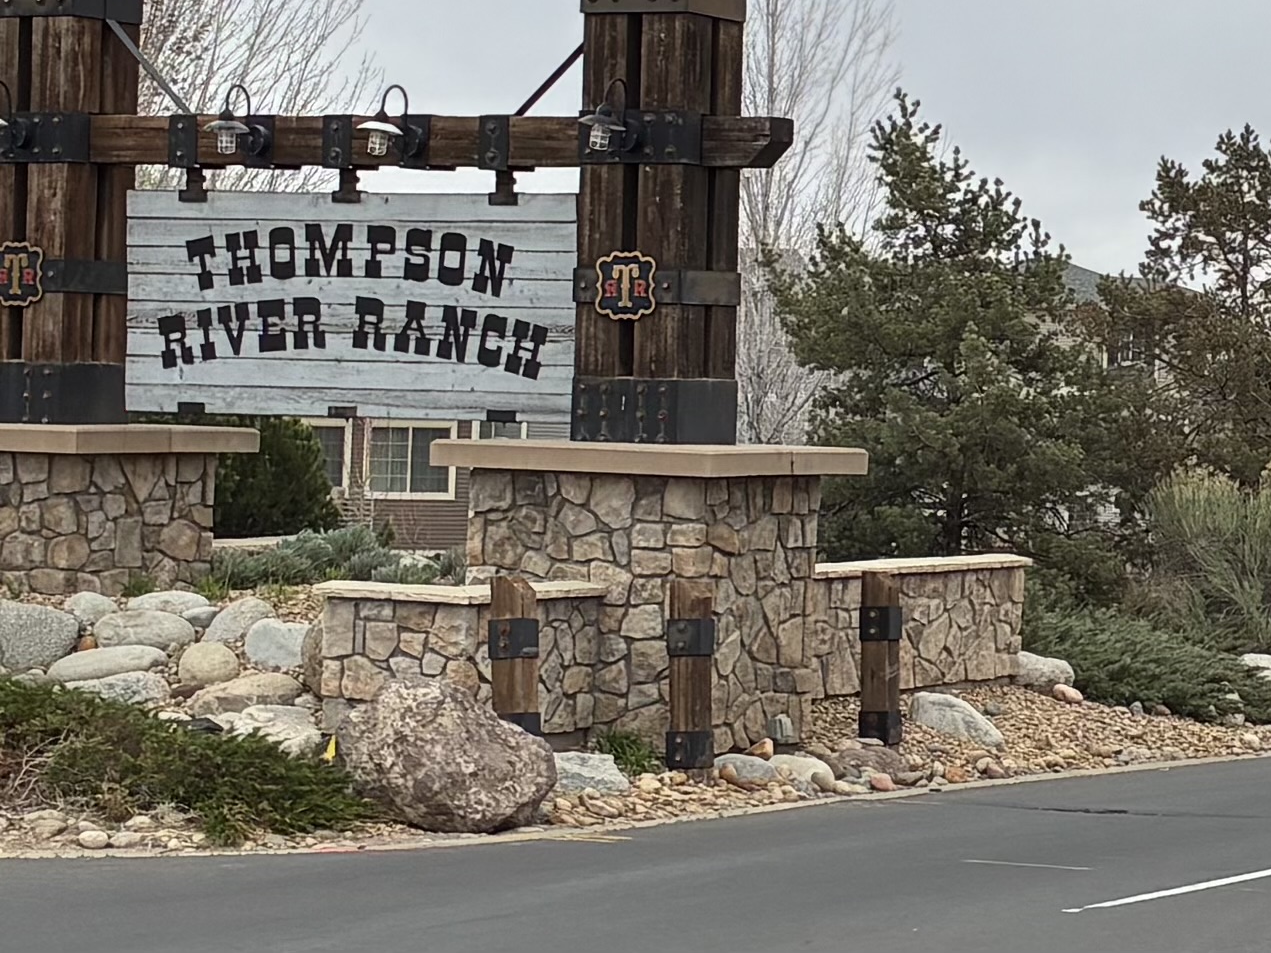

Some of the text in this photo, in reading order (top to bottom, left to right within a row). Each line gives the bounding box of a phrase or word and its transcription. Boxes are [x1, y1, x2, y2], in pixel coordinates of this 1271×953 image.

[185, 223, 515, 298] THOMPSON
[157, 296, 549, 381] RIVER RANCH
